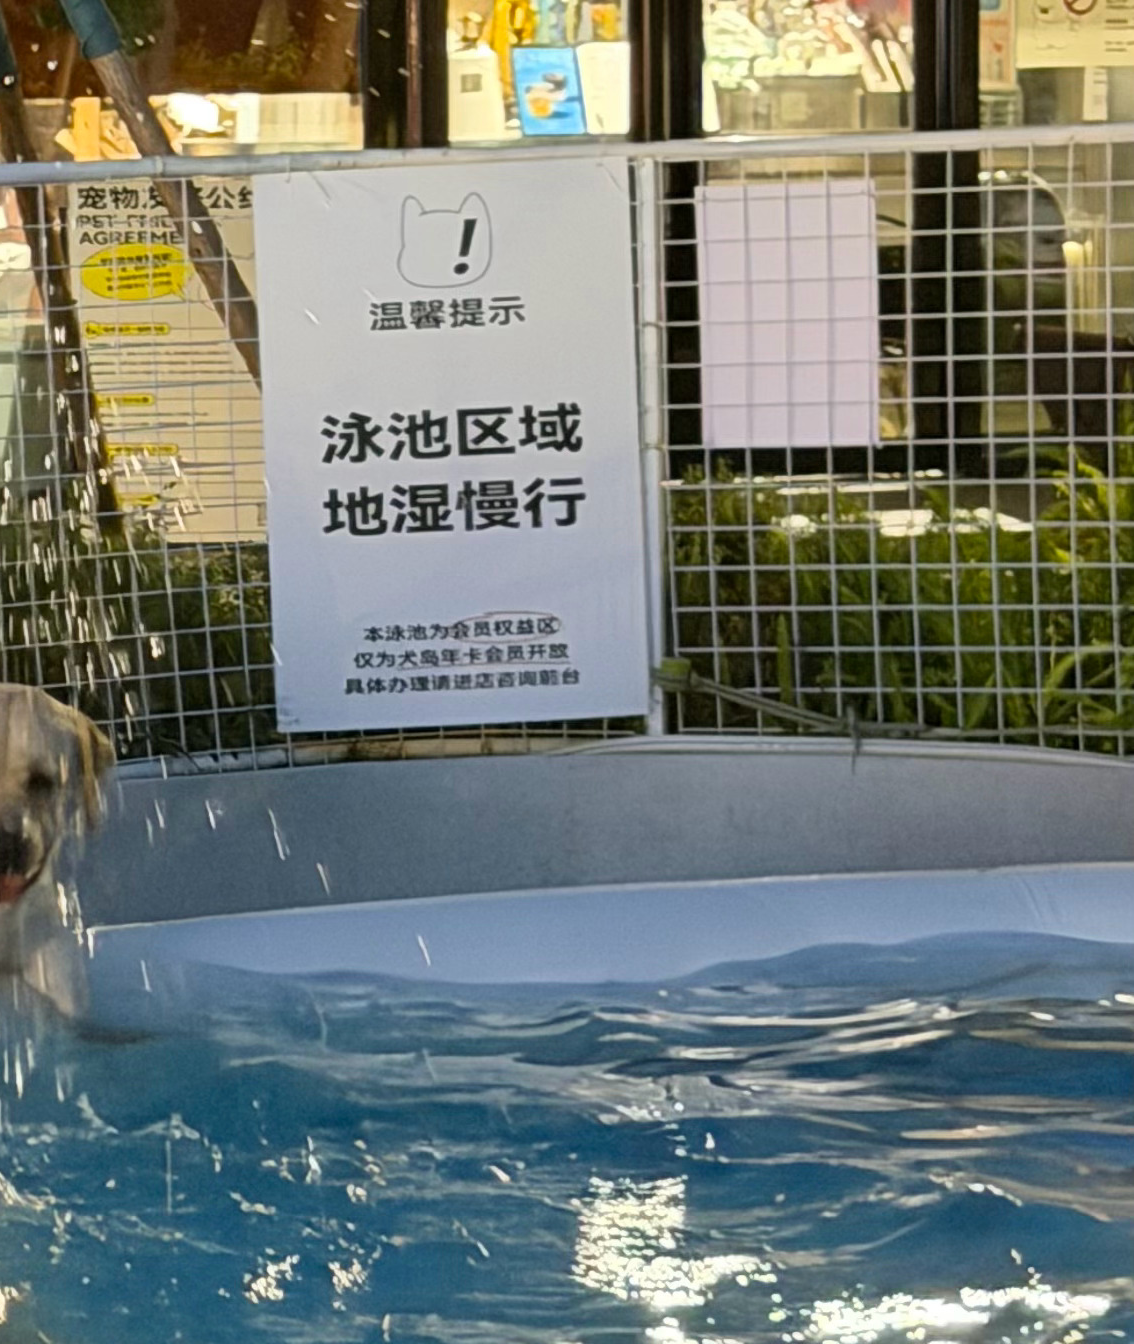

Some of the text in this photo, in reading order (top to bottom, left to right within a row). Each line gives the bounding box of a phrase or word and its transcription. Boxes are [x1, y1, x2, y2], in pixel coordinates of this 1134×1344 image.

[79, 230, 185, 245] AGREEME
[369, 296, 526, 331] 温馨提示
[320, 403, 583, 464] 泳池区域
[322, 477, 586, 536] 地湿慢行
[363, 616, 559, 642] 本泳池为会员权益区
[353, 643, 569, 668] 仅为犬岛年卡会员开放
